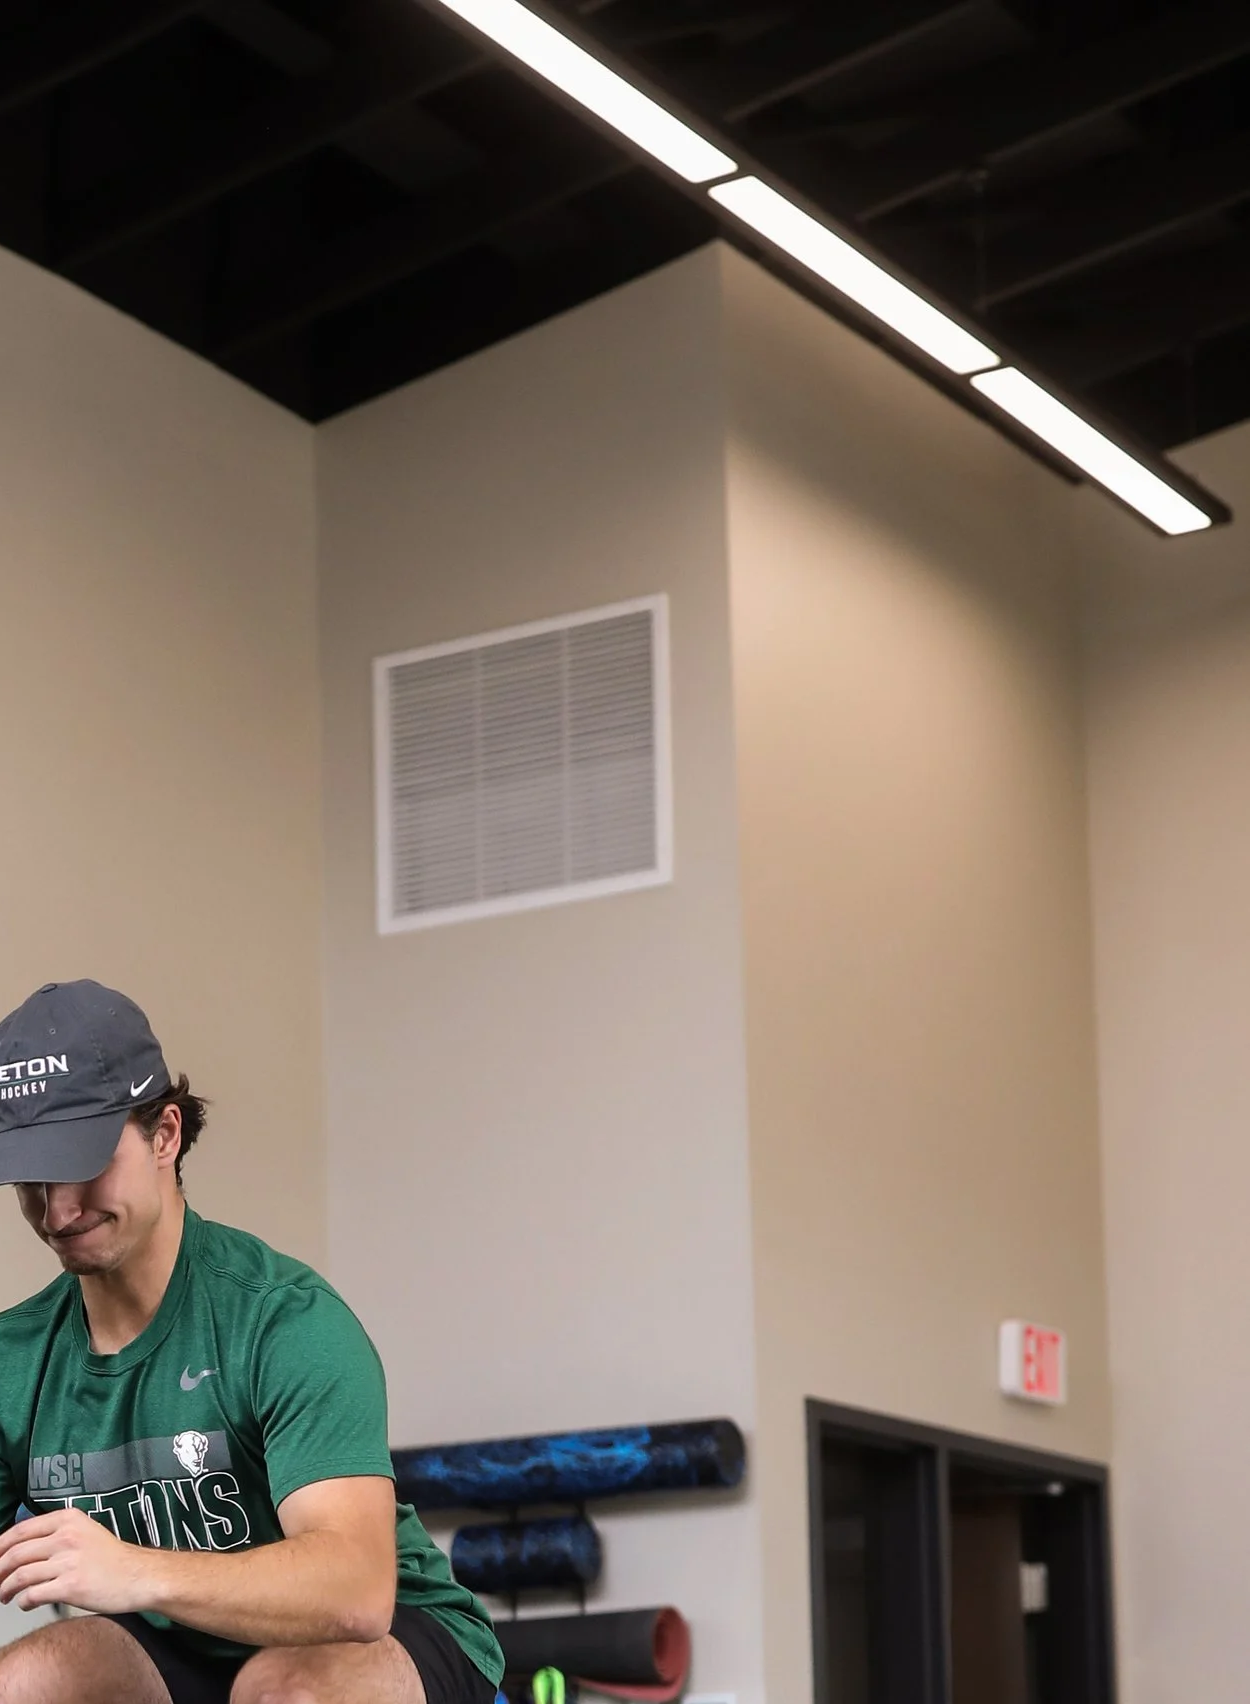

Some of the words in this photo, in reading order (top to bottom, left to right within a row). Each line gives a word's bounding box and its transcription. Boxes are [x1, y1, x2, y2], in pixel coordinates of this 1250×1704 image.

[0, 1080, 47, 1100] HOCKEY
[29, 1453, 84, 1490] WSC
[33, 1472, 250, 1551] TONS
